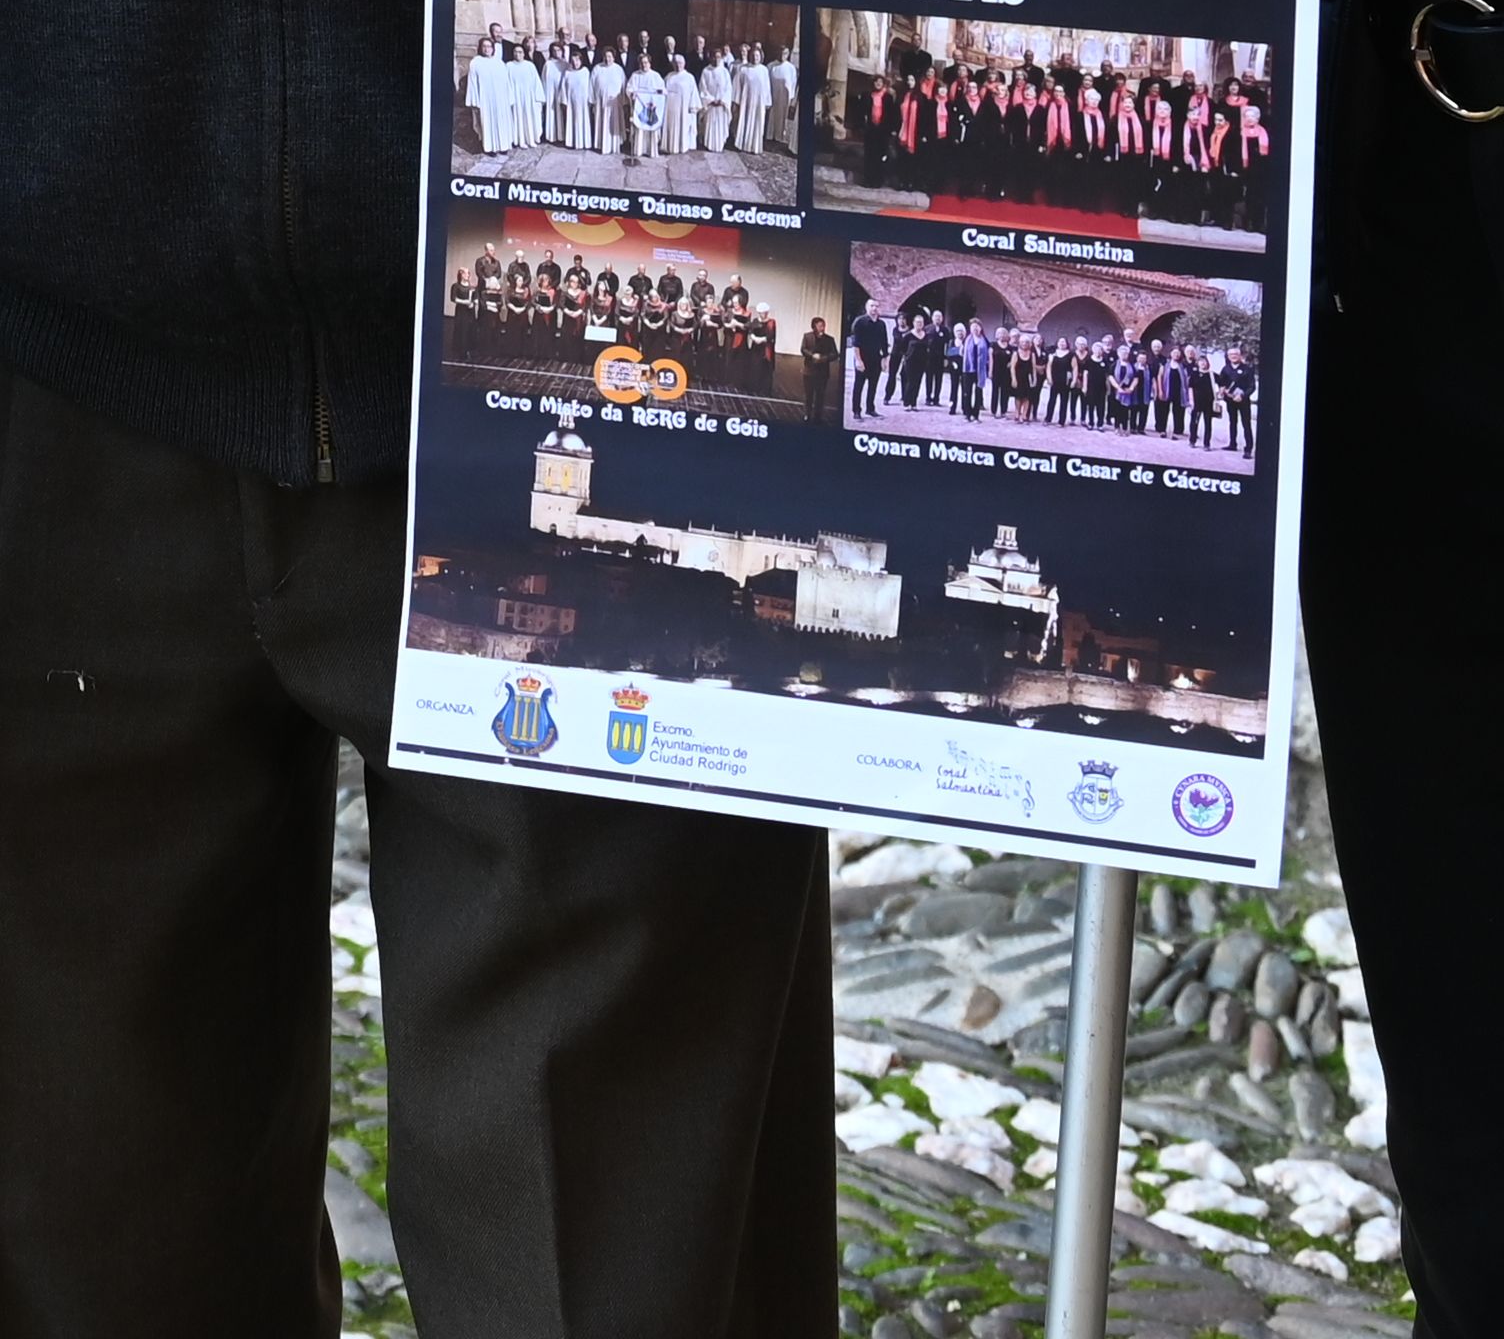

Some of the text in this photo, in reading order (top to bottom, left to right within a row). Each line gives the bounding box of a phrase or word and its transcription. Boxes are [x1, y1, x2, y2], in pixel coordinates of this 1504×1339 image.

[451, 179, 500, 199] Coral
[508, 183, 629, 211] Mirobrigense
[962, 229, 1133, 262] Coral Salmantina
[486, 391, 531, 411] Coro
[540, 395, 592, 418] Misto
[601, 404, 622, 421] da
[695, 414, 717, 432] de
[726, 417, 768, 438] Góis
[854, 434, 920, 458] Cynara
[1004, 451, 1057, 473] Coral
[1067, 459, 1121, 480] Casar
[1130, 466, 1154, 484] de
[1163, 469, 1240, 494] Cáceres
[650, 750, 747, 774] Ciudad Rodrigo
[651, 736, 747, 759] Ayuntamiento de
